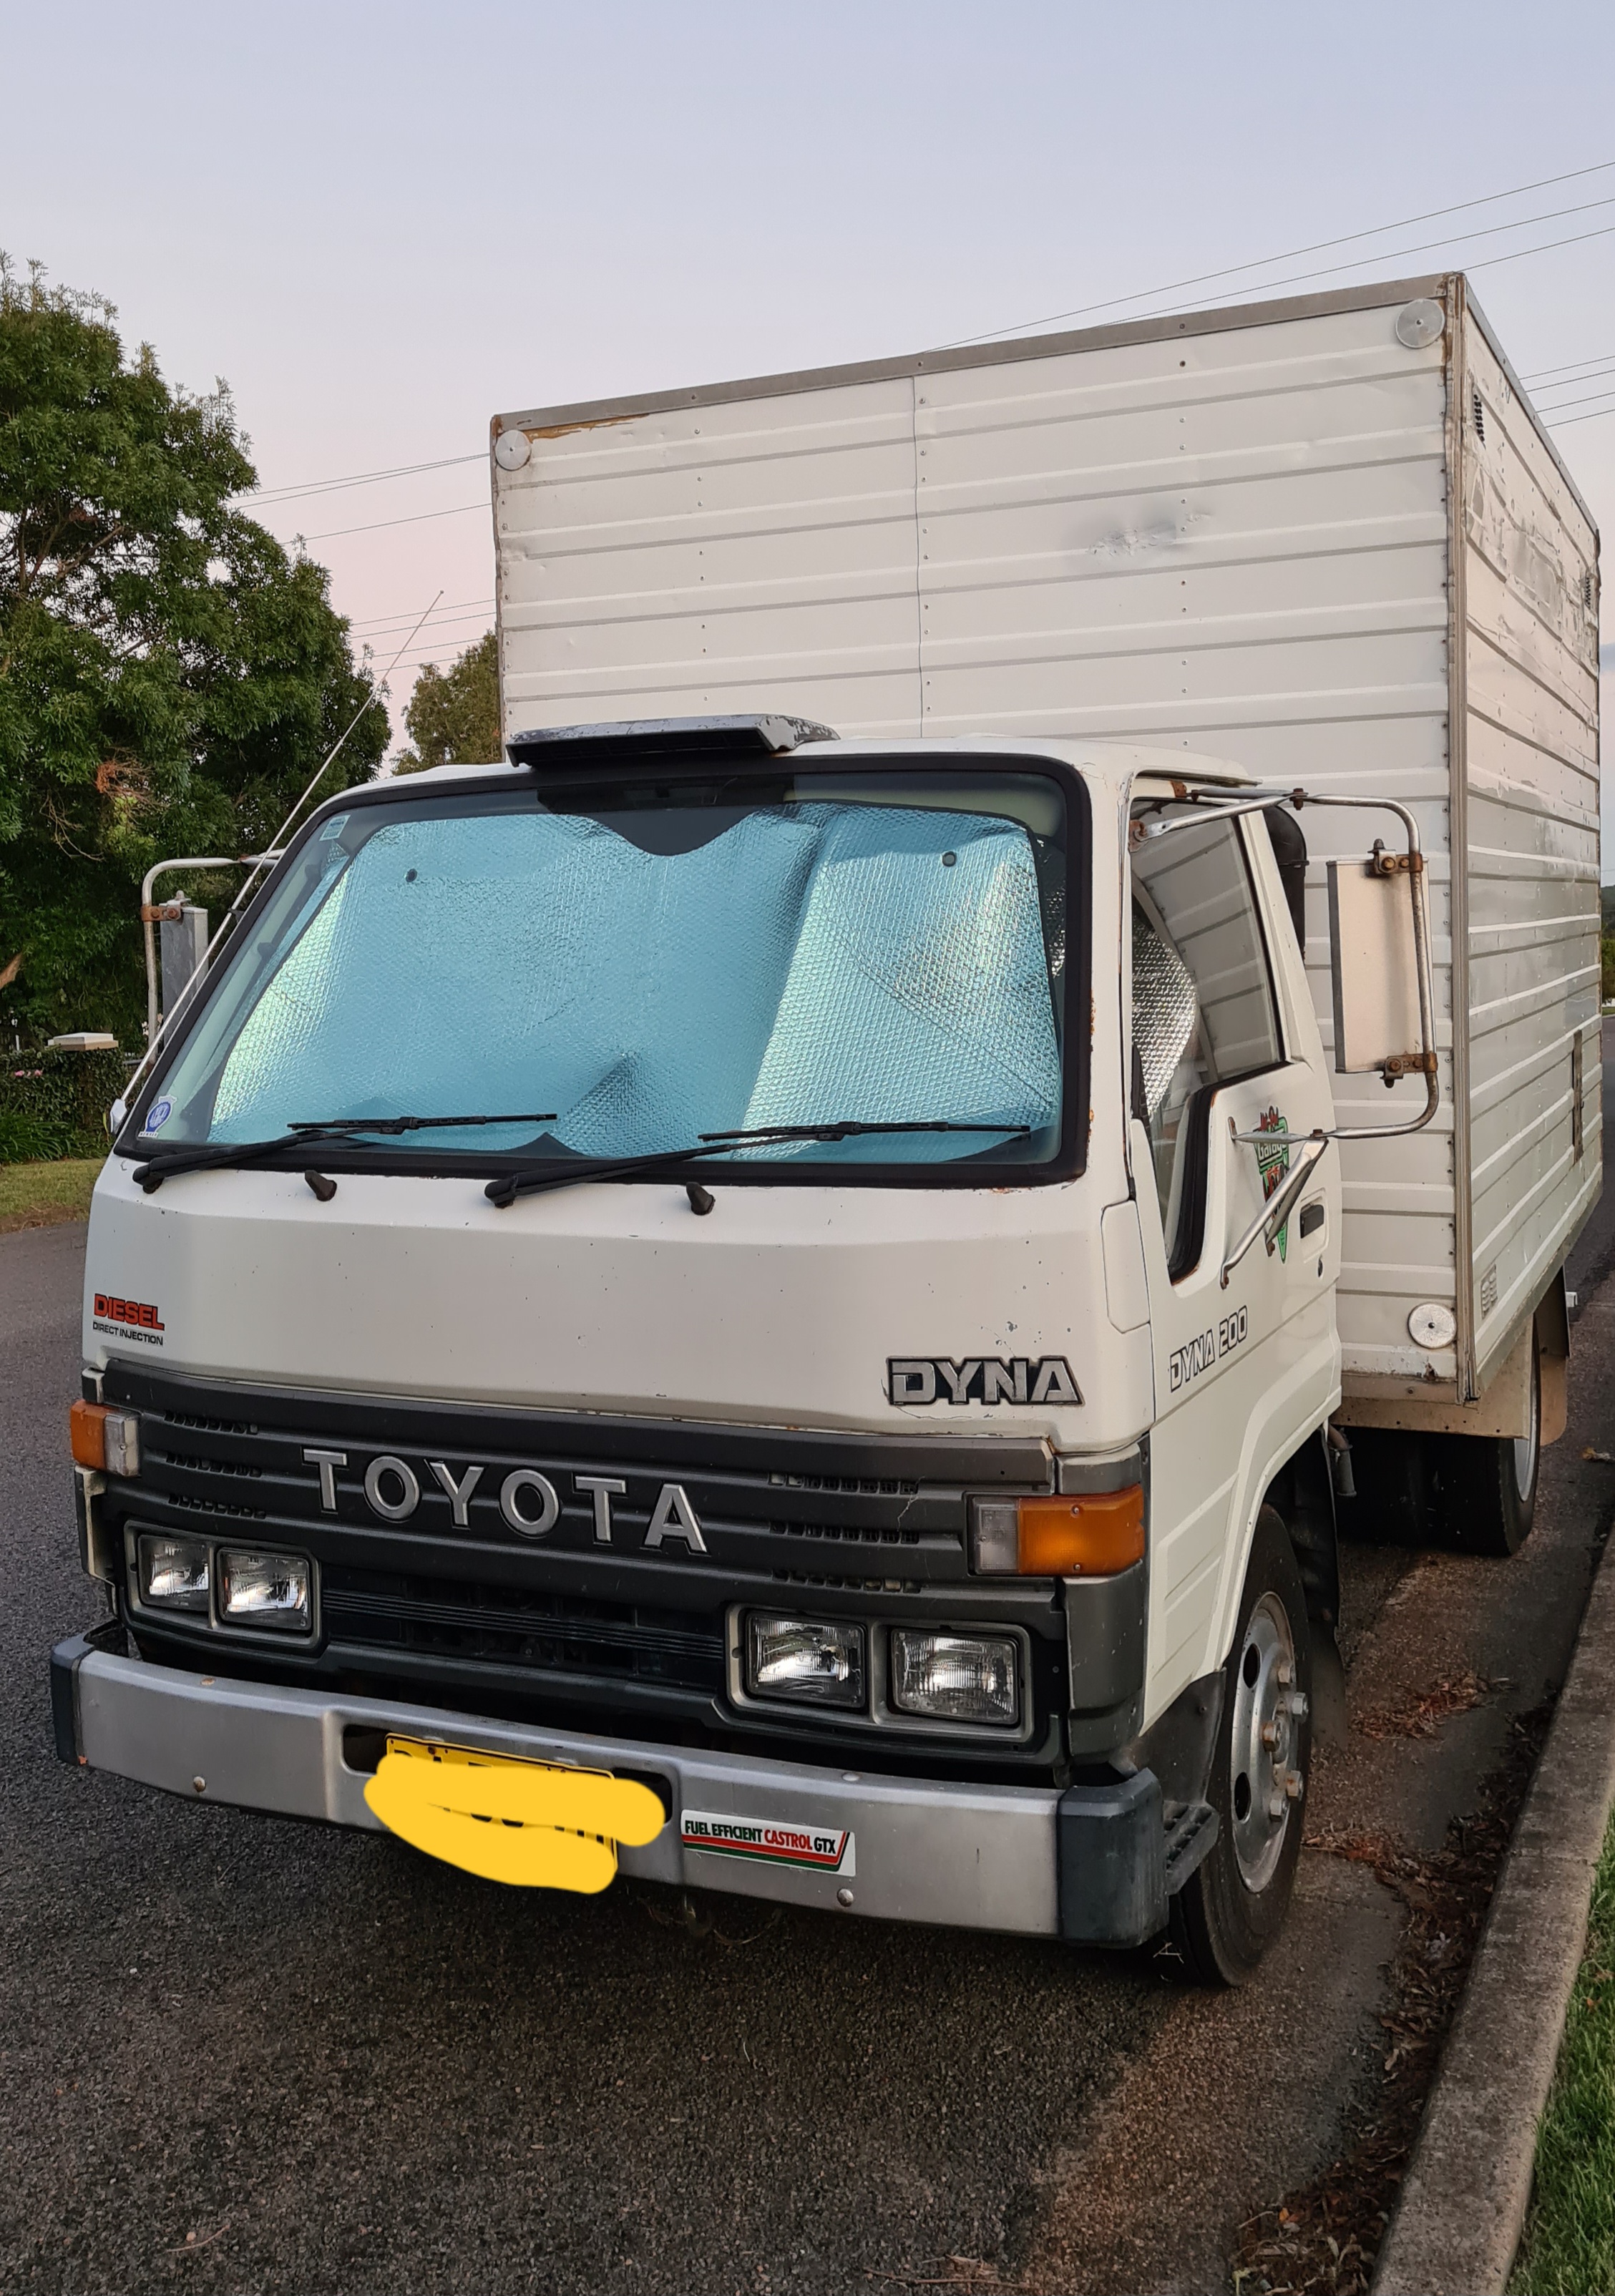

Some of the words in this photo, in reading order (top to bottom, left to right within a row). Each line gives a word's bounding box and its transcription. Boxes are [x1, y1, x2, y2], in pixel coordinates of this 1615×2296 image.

[94, 1293, 165, 1331] DIESEL
[93, 1322, 119, 1334] DIRECT
[119, 1328, 163, 1346] INJECTION
[1170, 1329, 1215, 1392] DYNA
[1219, 1305, 1247, 1358] 200
[888, 1356, 1083, 1405] DYNA
[301, 1447, 709, 1554] TOYOTA
[685, 1820, 711, 1835] FUEL
[711, 1824, 763, 1843] EFFICIENT
[764, 1830, 812, 1850] CASTROL
[814, 1837, 836, 1854] GTX
